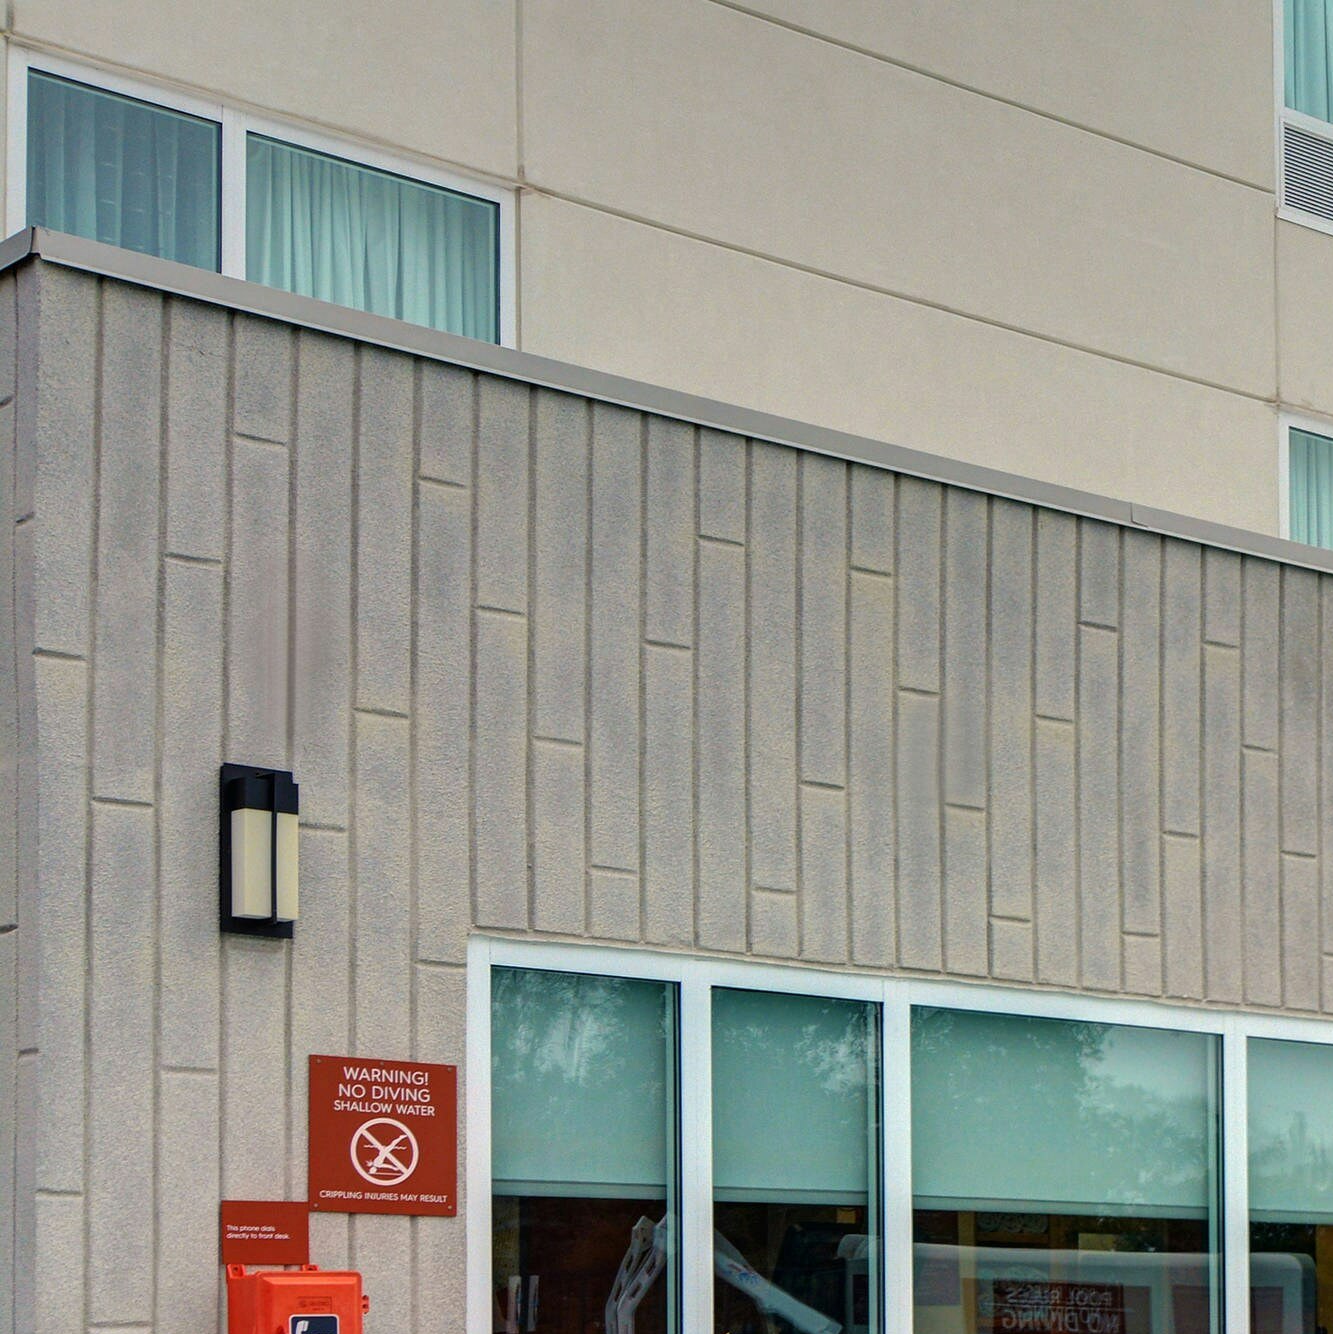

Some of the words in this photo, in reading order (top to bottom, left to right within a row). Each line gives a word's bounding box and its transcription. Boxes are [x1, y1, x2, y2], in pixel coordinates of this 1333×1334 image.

[343, 1066, 429, 1086] WARNING!
[338, 1083, 366, 1098] NO
[372, 1085, 431, 1103] DIVING
[333, 1100, 393, 1113] SHALLOW
[396, 1104, 435, 1117] WATER
[319, 1190, 363, 1200] CRIPPLING
[364, 1191, 399, 1201] INJURIES
[400, 1193, 418, 1202] MAY
[420, 1194, 448, 1203] RESULT
